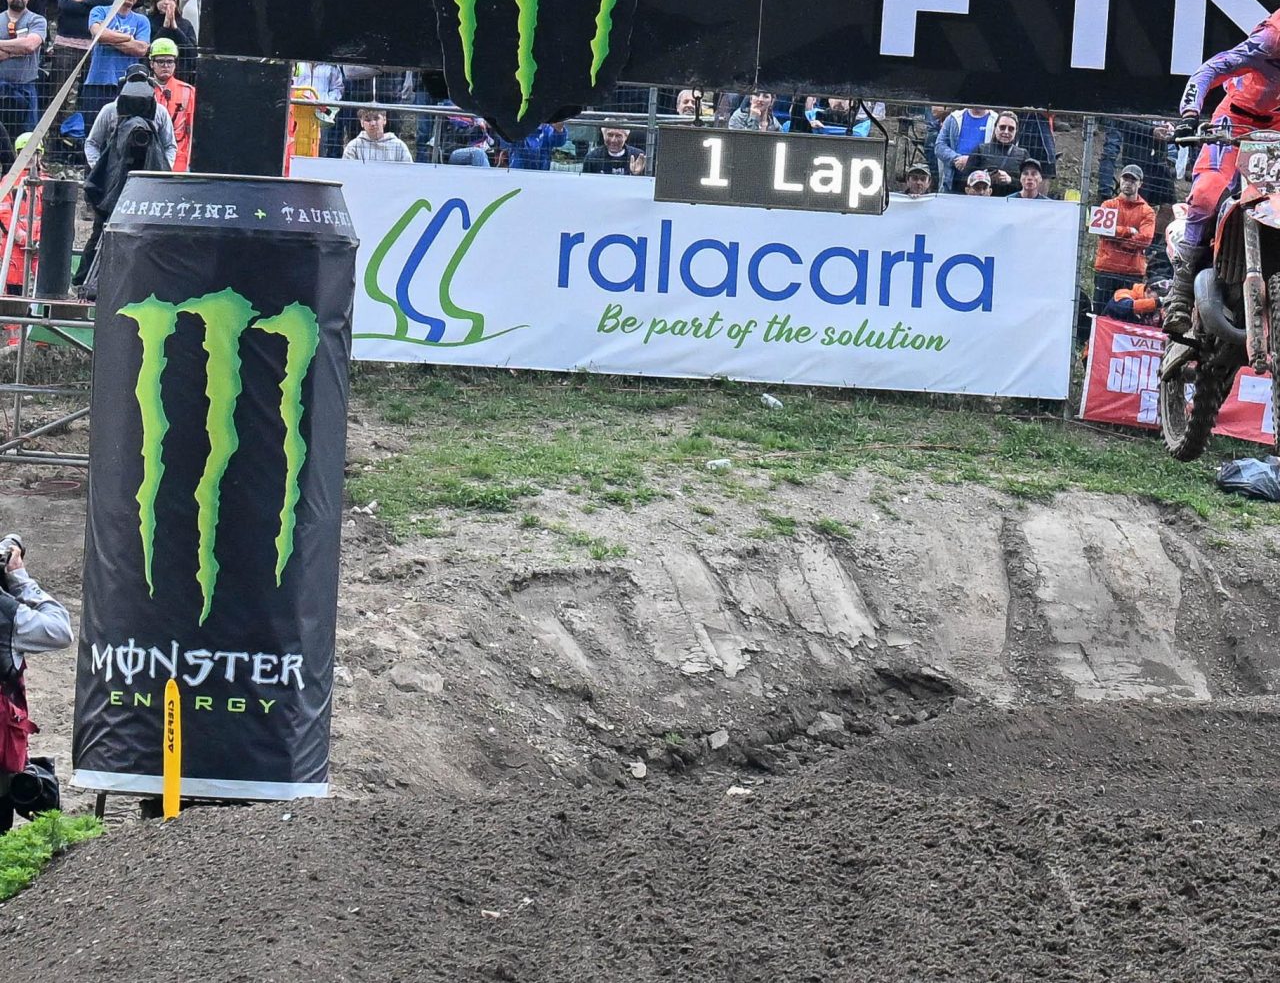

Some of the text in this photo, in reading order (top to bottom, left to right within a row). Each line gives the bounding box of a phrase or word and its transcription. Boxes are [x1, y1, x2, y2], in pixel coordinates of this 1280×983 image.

[700, 137, 884, 209] 1 Lap
[1090, 209, 1116, 229] 28
[558, 219, 996, 313] ralacarta
[597, 303, 951, 352] Be part of the solution
[91, 638, 305, 690] MONSTER
[110, 691, 276, 714] ENRGY
[168, 699, 176, 754] ACERBIS
